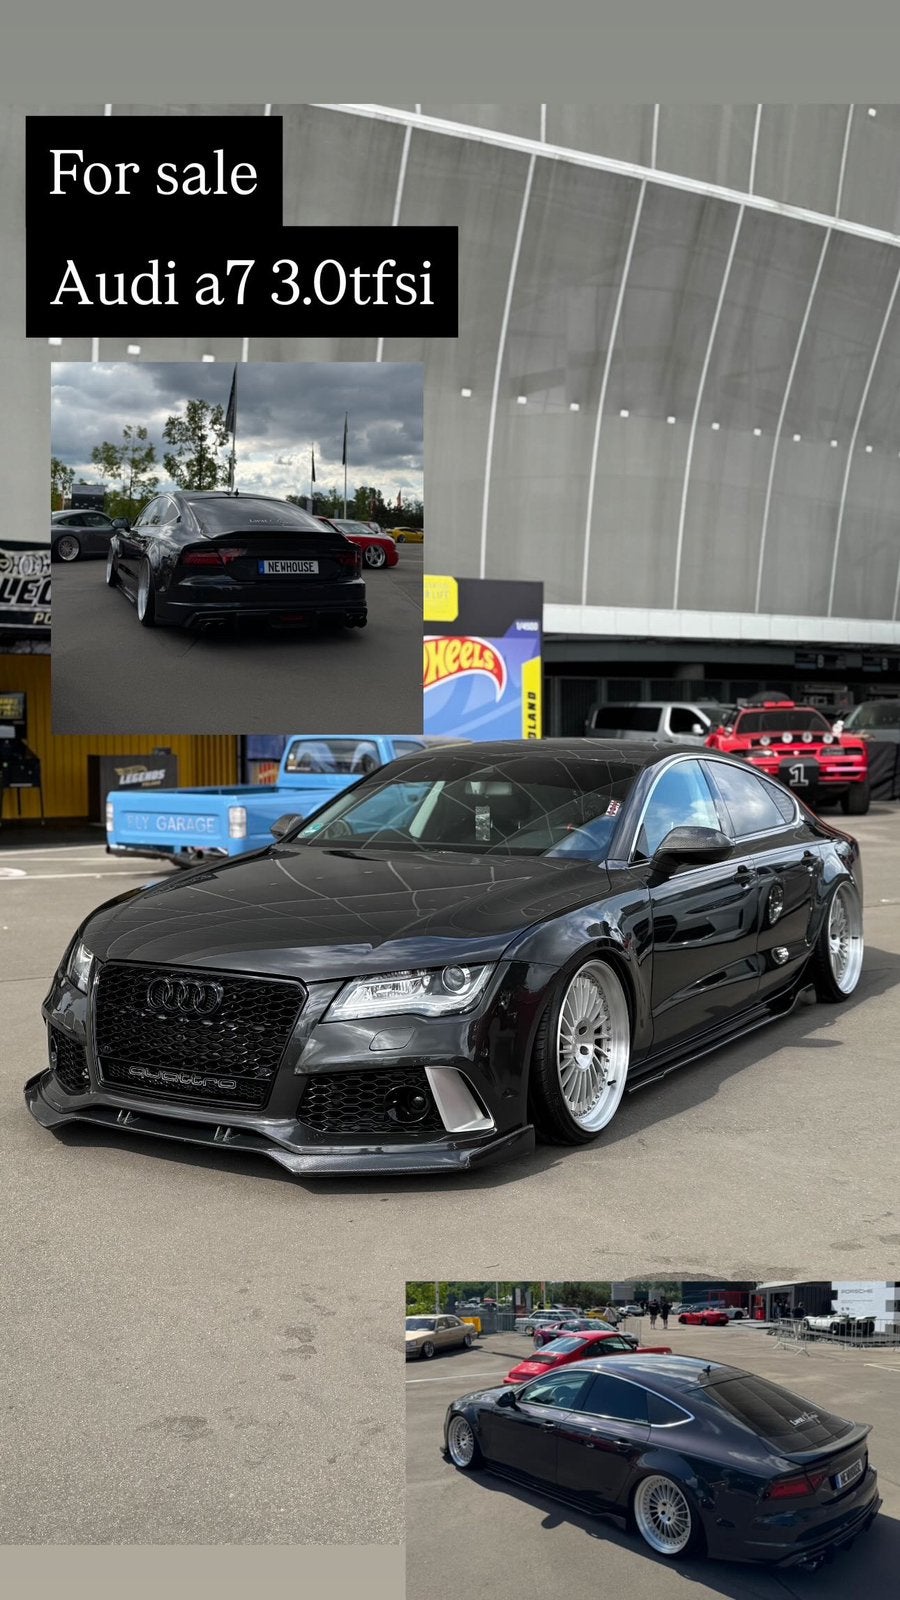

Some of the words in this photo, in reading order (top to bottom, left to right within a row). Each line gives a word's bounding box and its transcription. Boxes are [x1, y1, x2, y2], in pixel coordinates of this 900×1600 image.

[268, 561, 315, 573] NEWHOUSE
[119, 769, 166, 785] LEGENDS
[789, 763, 809, 786] 1
[156, 815, 216, 833] GARAGE
[129, 1066, 237, 1089] quattro
